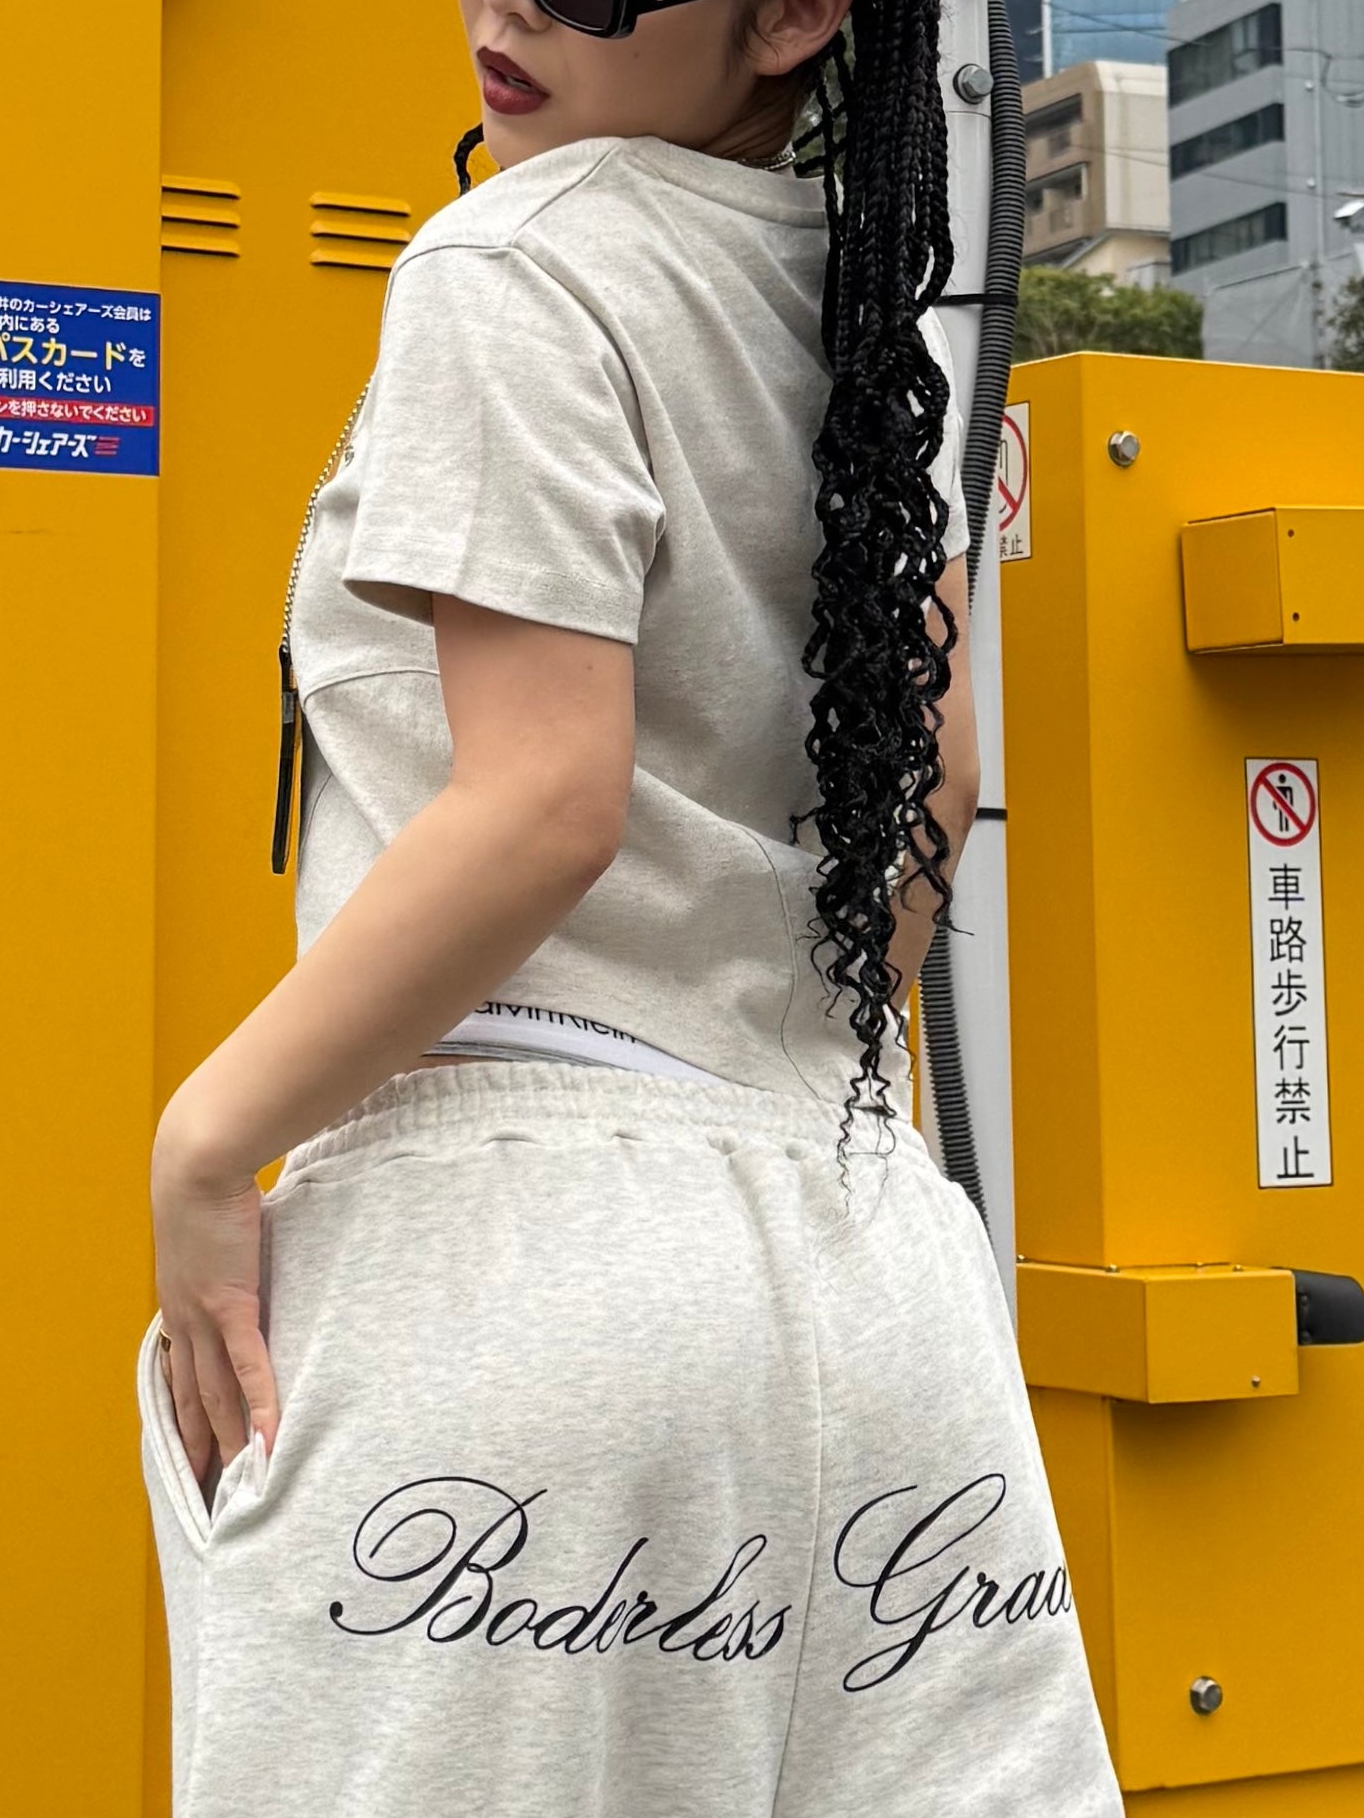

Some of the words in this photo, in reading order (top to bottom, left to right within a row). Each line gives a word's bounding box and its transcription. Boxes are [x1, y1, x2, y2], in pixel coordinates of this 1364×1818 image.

[1267, 862, 1316, 1180] 車路歩行禁止
[329, 1475, 794, 1663] Boderless
